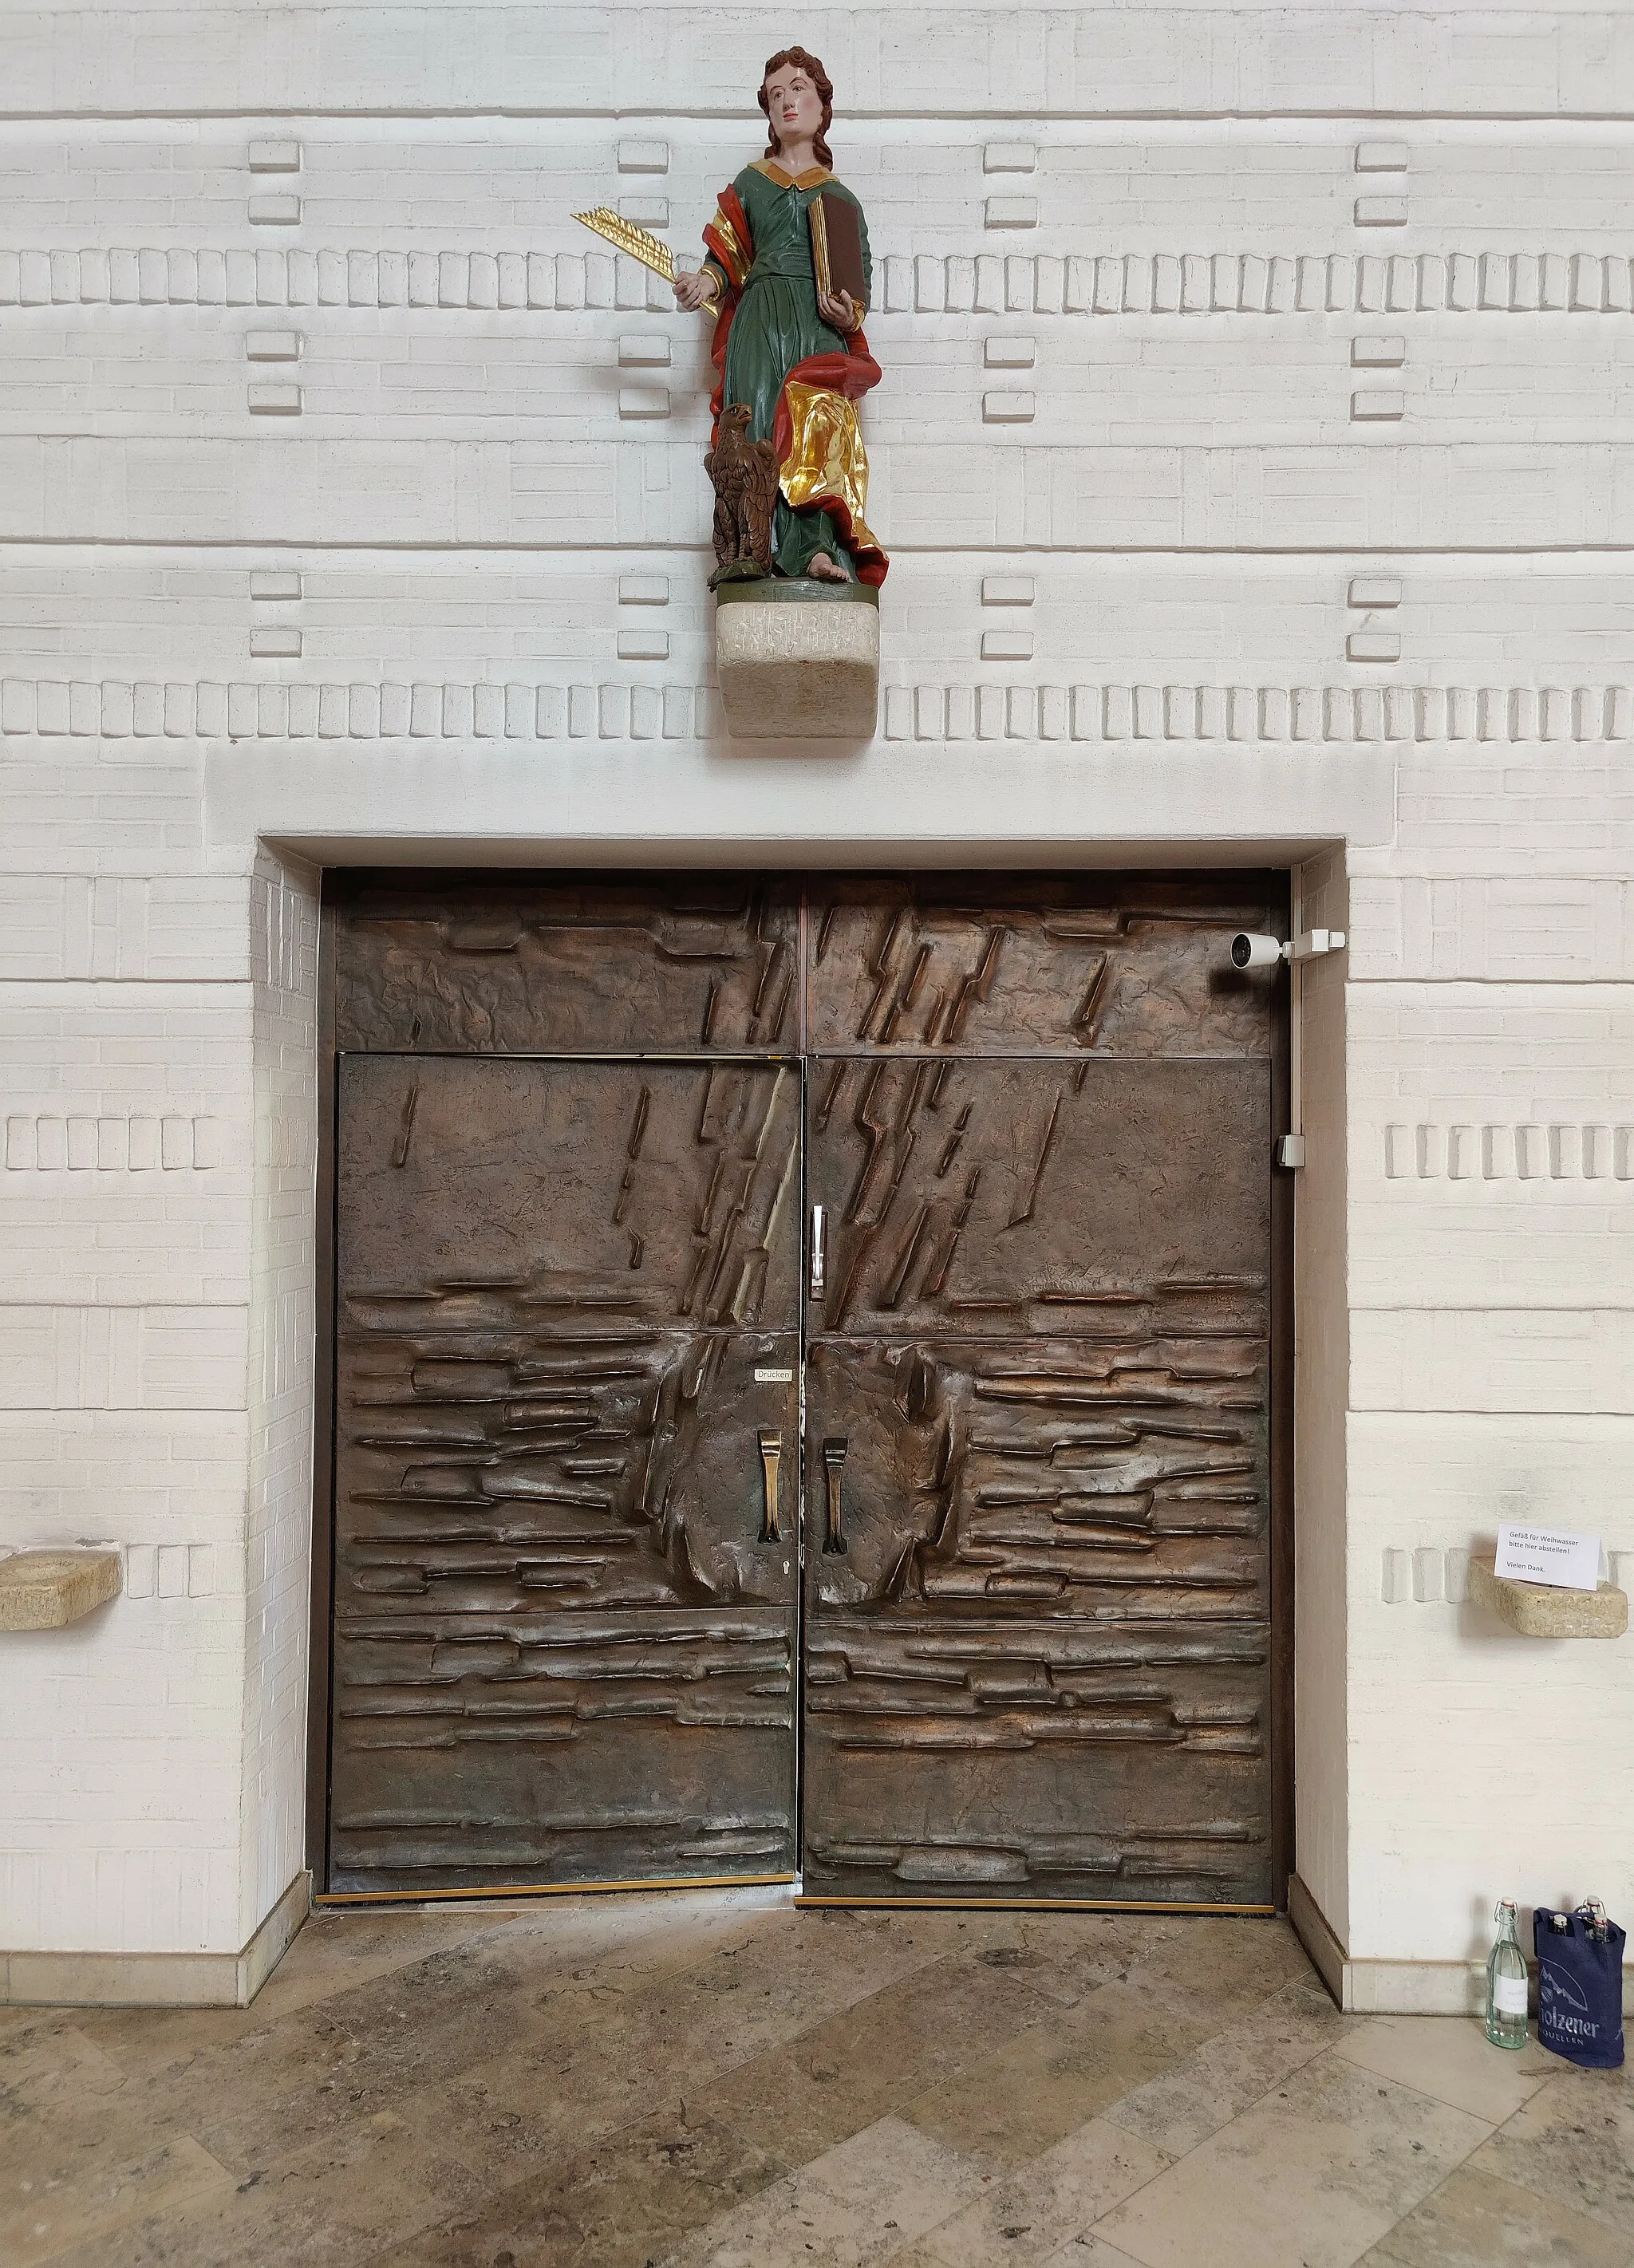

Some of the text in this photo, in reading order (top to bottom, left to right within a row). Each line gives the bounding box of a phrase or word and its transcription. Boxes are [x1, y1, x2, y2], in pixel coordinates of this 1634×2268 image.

[1510, 1531, 1529, 1540] Gefäß
[1540, 1535, 1579, 1546] Weihwasser
[1538, 1544, 1570, 1554] abstellen!
[1527, 1564, 1545, 1572] Dank.
[1542, 2029, 1585, 2045] QUELLEN
